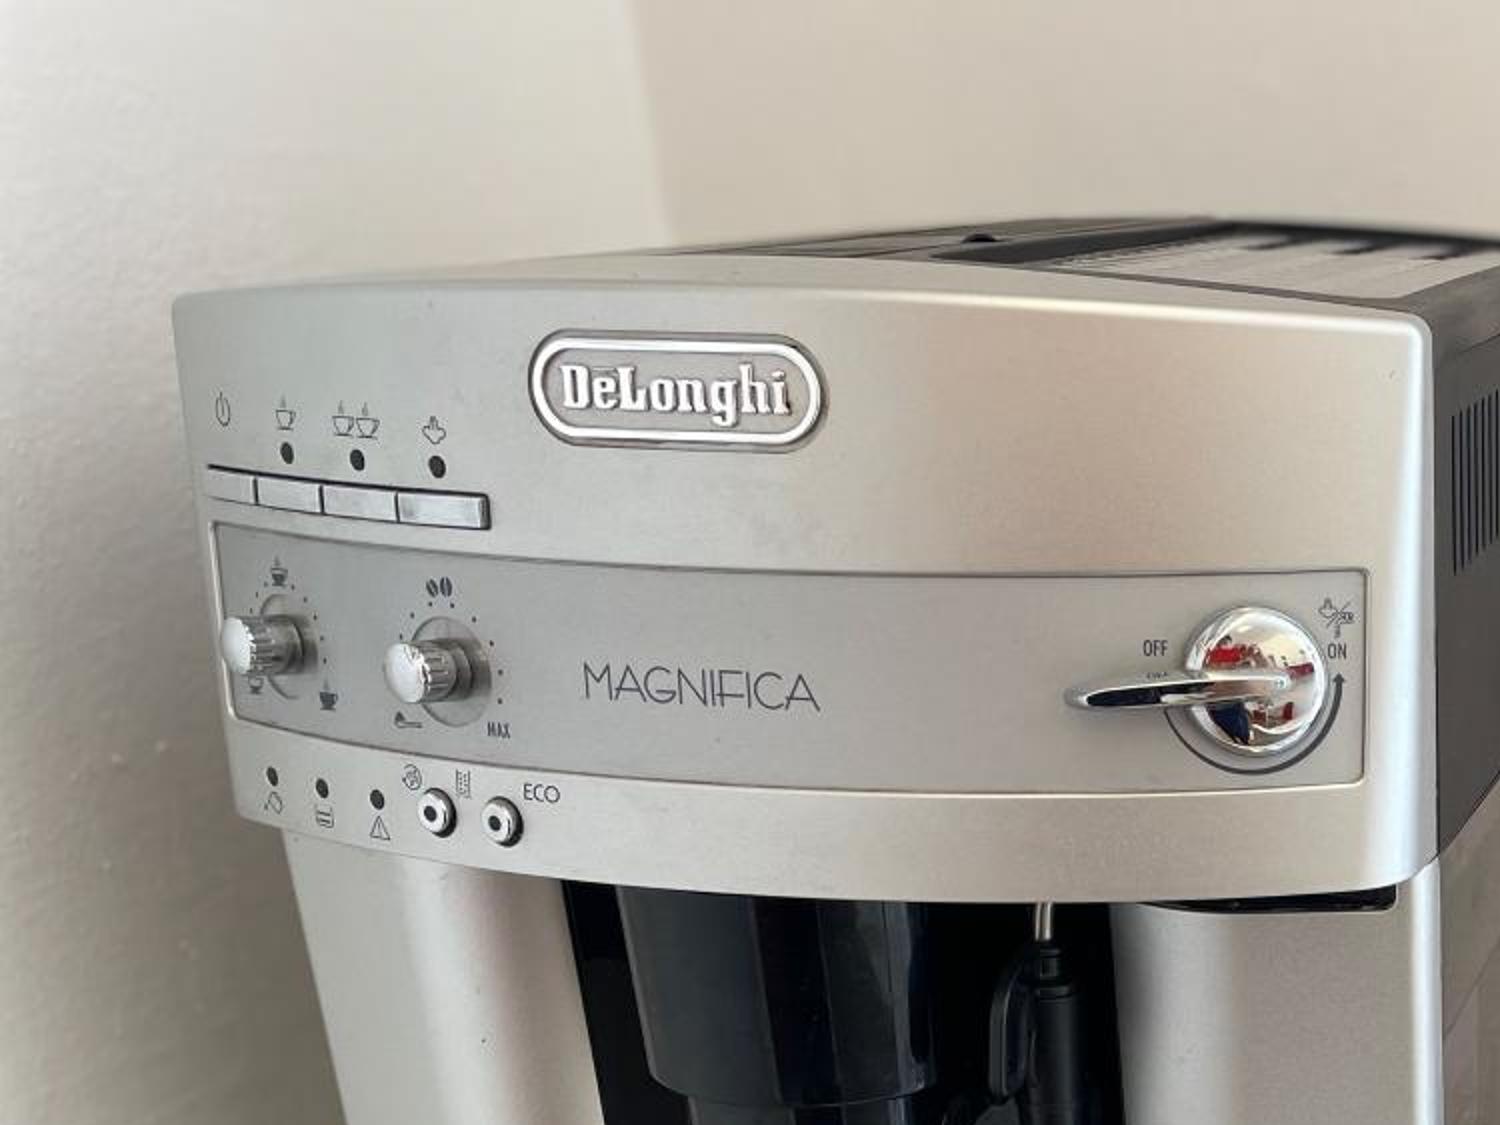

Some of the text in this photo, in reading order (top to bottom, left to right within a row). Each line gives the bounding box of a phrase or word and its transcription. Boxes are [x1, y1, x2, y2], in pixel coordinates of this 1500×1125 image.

[1143, 639, 1168, 657] OFF
[1327, 643, 1347, 659] ON
[583, 661, 821, 712] MAGNIFICA
[487, 721, 511, 739] MAX
[523, 783, 560, 803] ECO
